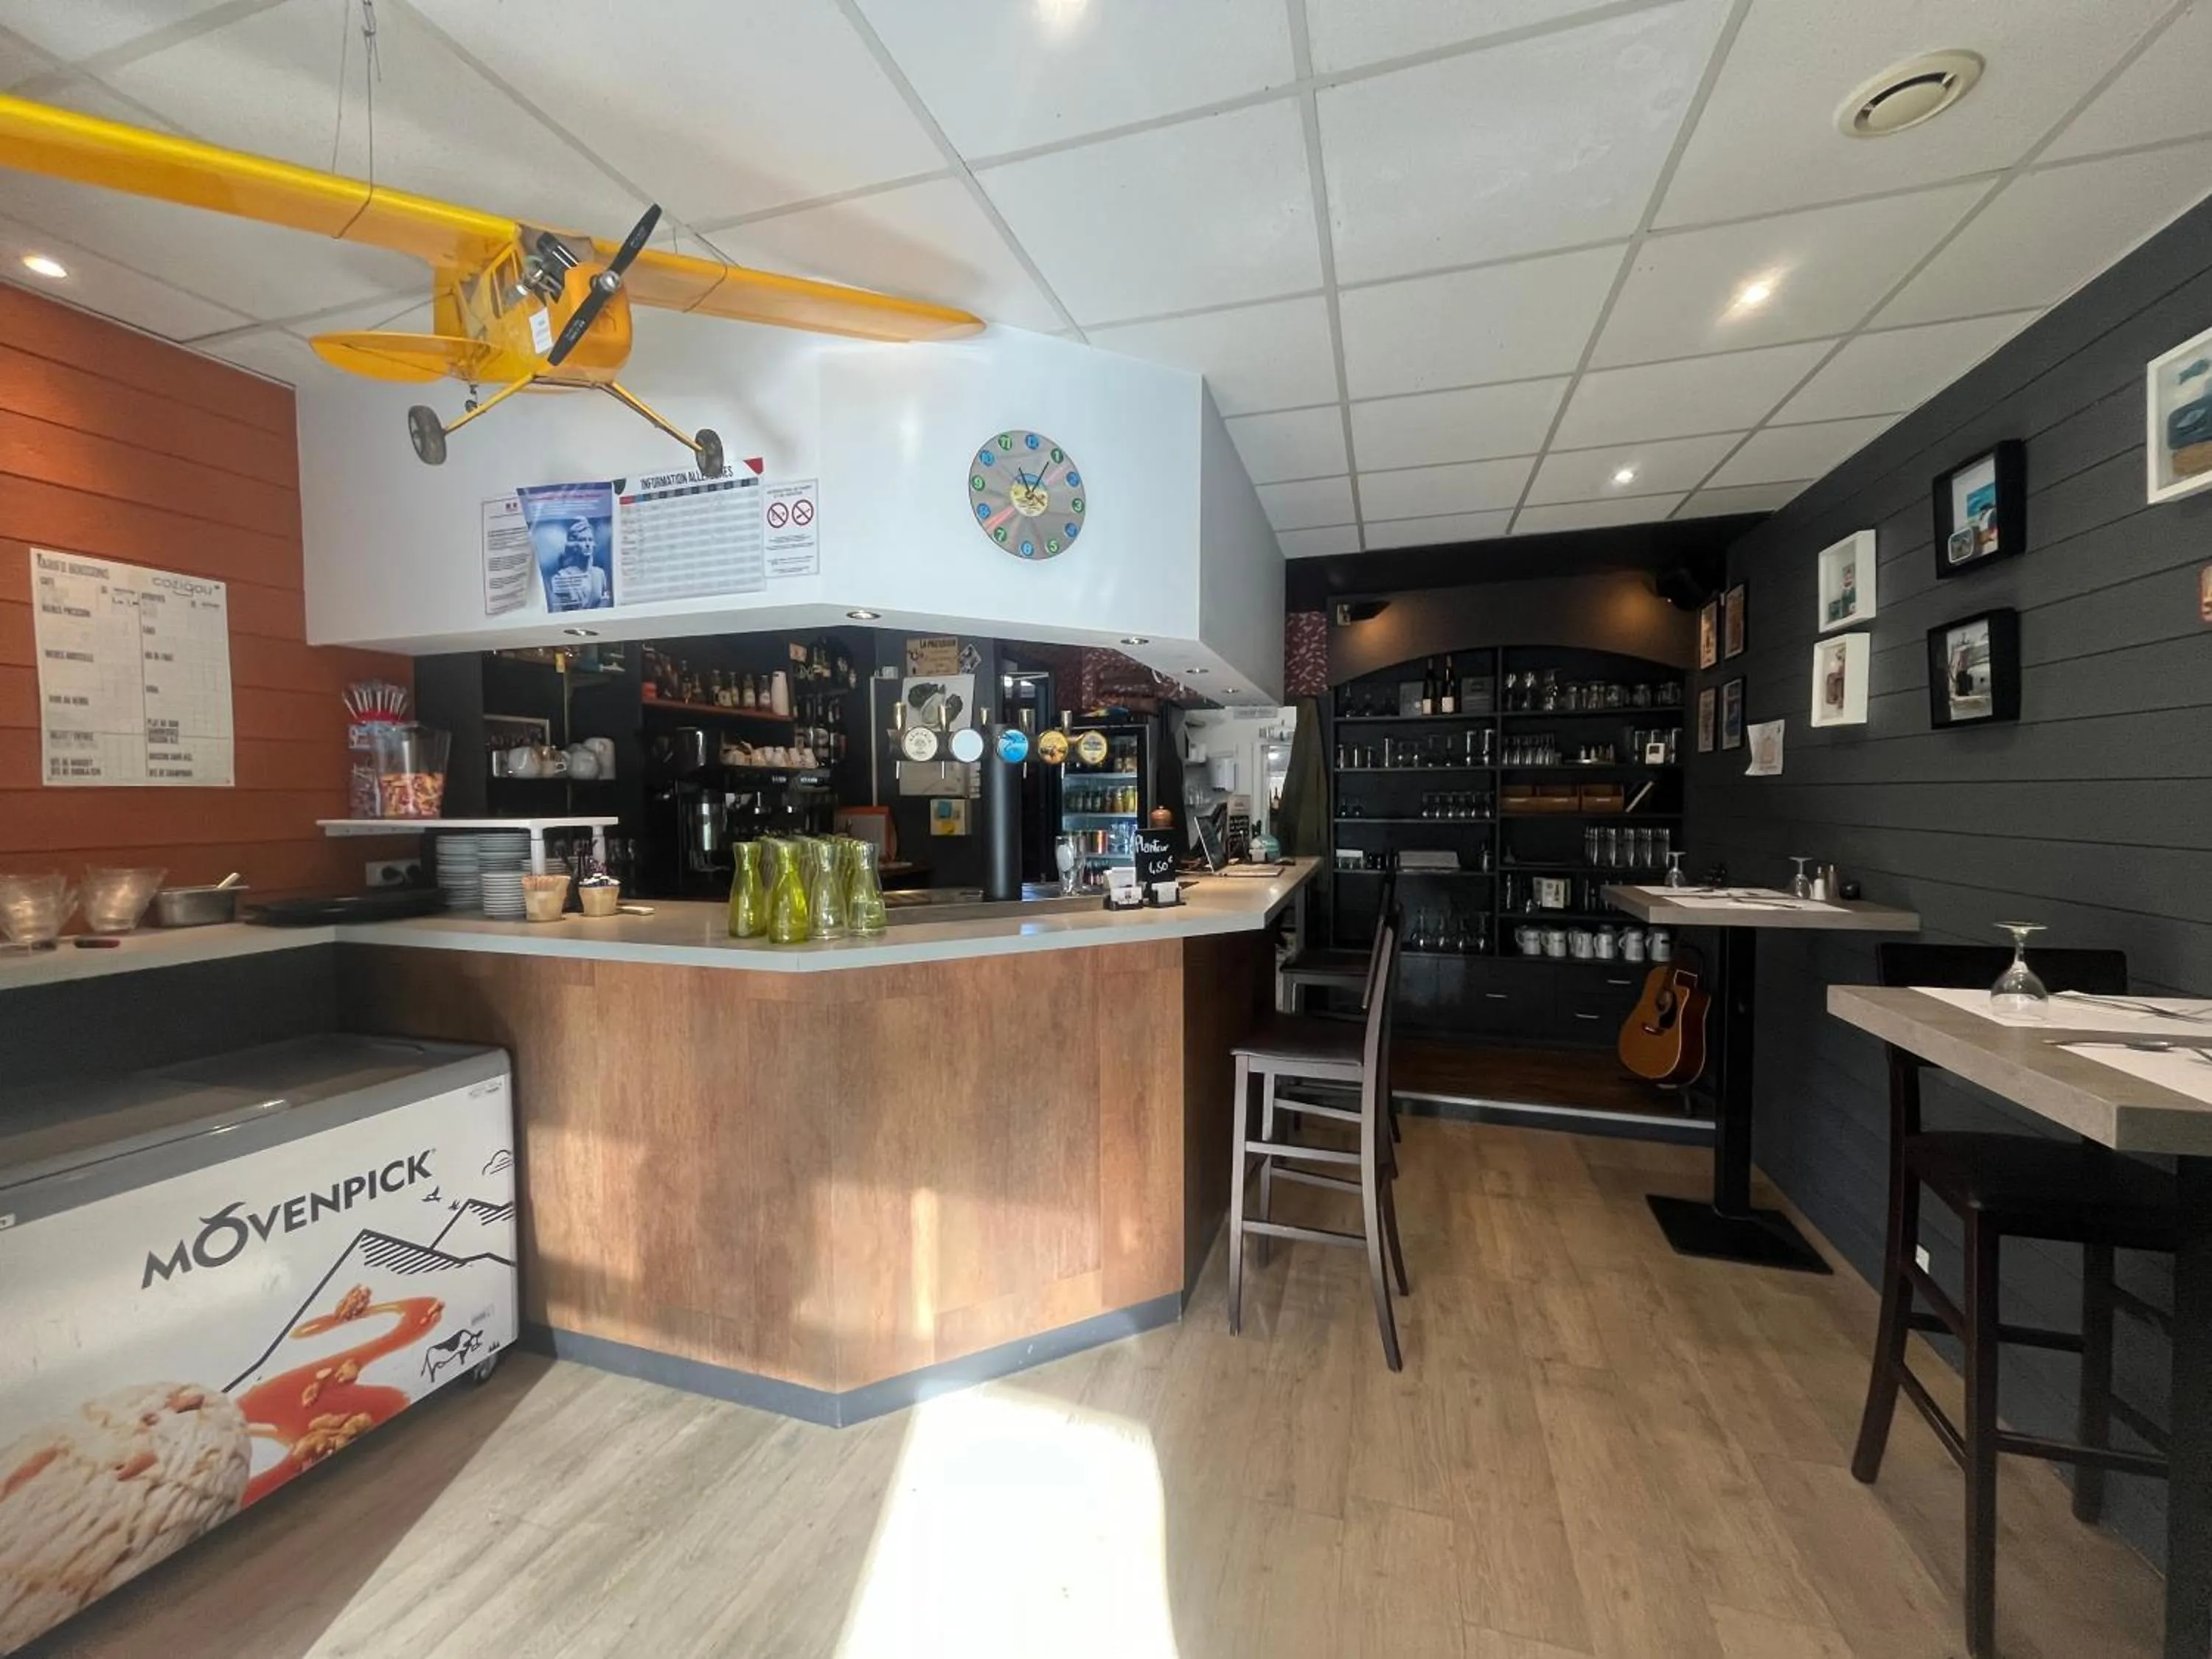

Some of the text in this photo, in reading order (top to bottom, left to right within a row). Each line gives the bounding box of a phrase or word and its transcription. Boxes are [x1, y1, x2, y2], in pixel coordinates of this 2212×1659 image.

[1000, 436, 1011, 450] 11
[640, 471, 688, 490] INFORMATION
[975, 476, 982, 490] 9
[1074, 499, 1082, 512] 3
[997, 529, 1004, 540] 7
[1050, 540, 1058, 552] 5
